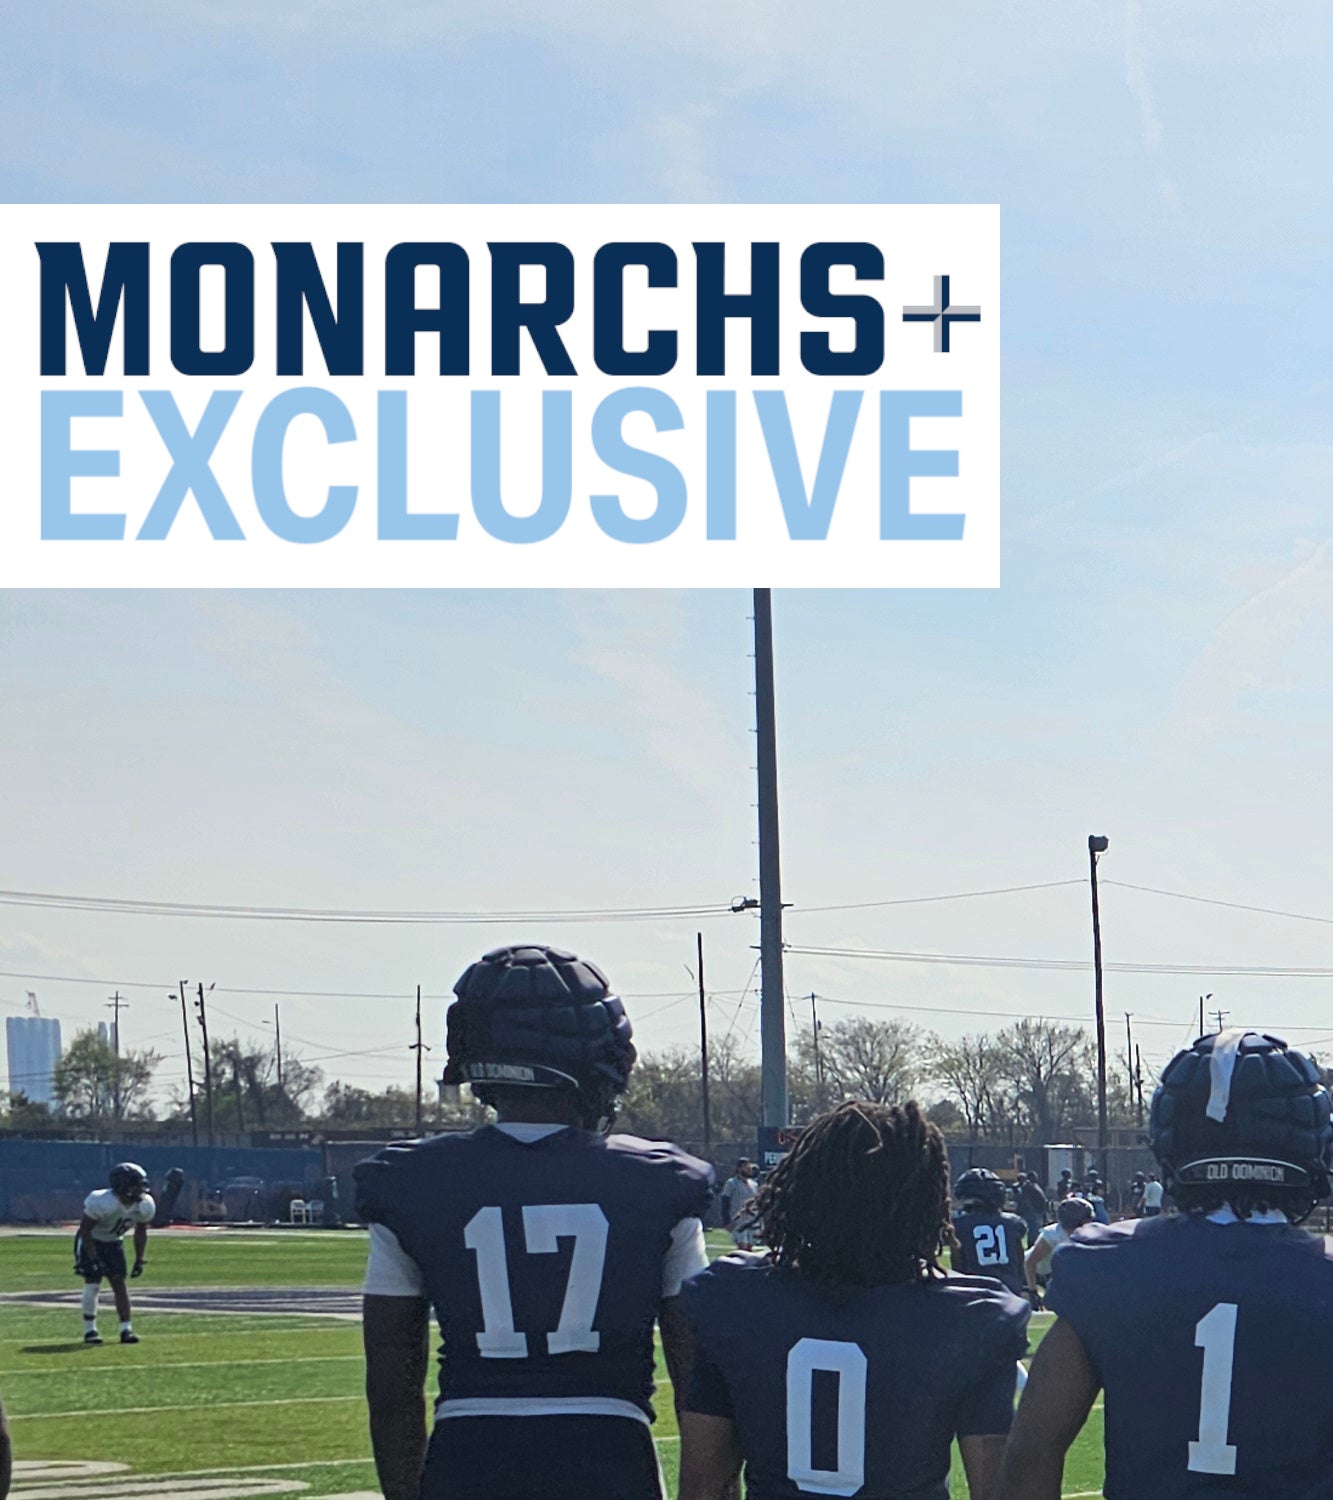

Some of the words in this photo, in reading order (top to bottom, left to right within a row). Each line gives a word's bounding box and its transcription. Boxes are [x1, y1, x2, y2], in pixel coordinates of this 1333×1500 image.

[973, 1225, 1009, 1266] 21
[1207, 1163, 1228, 1180] OLD
[1232, 1163, 1284, 1182] DOMINION
[464, 1203, 609, 1358] 17
[786, 1337, 868, 1497] 0
[1187, 1302, 1238, 1475] 1
